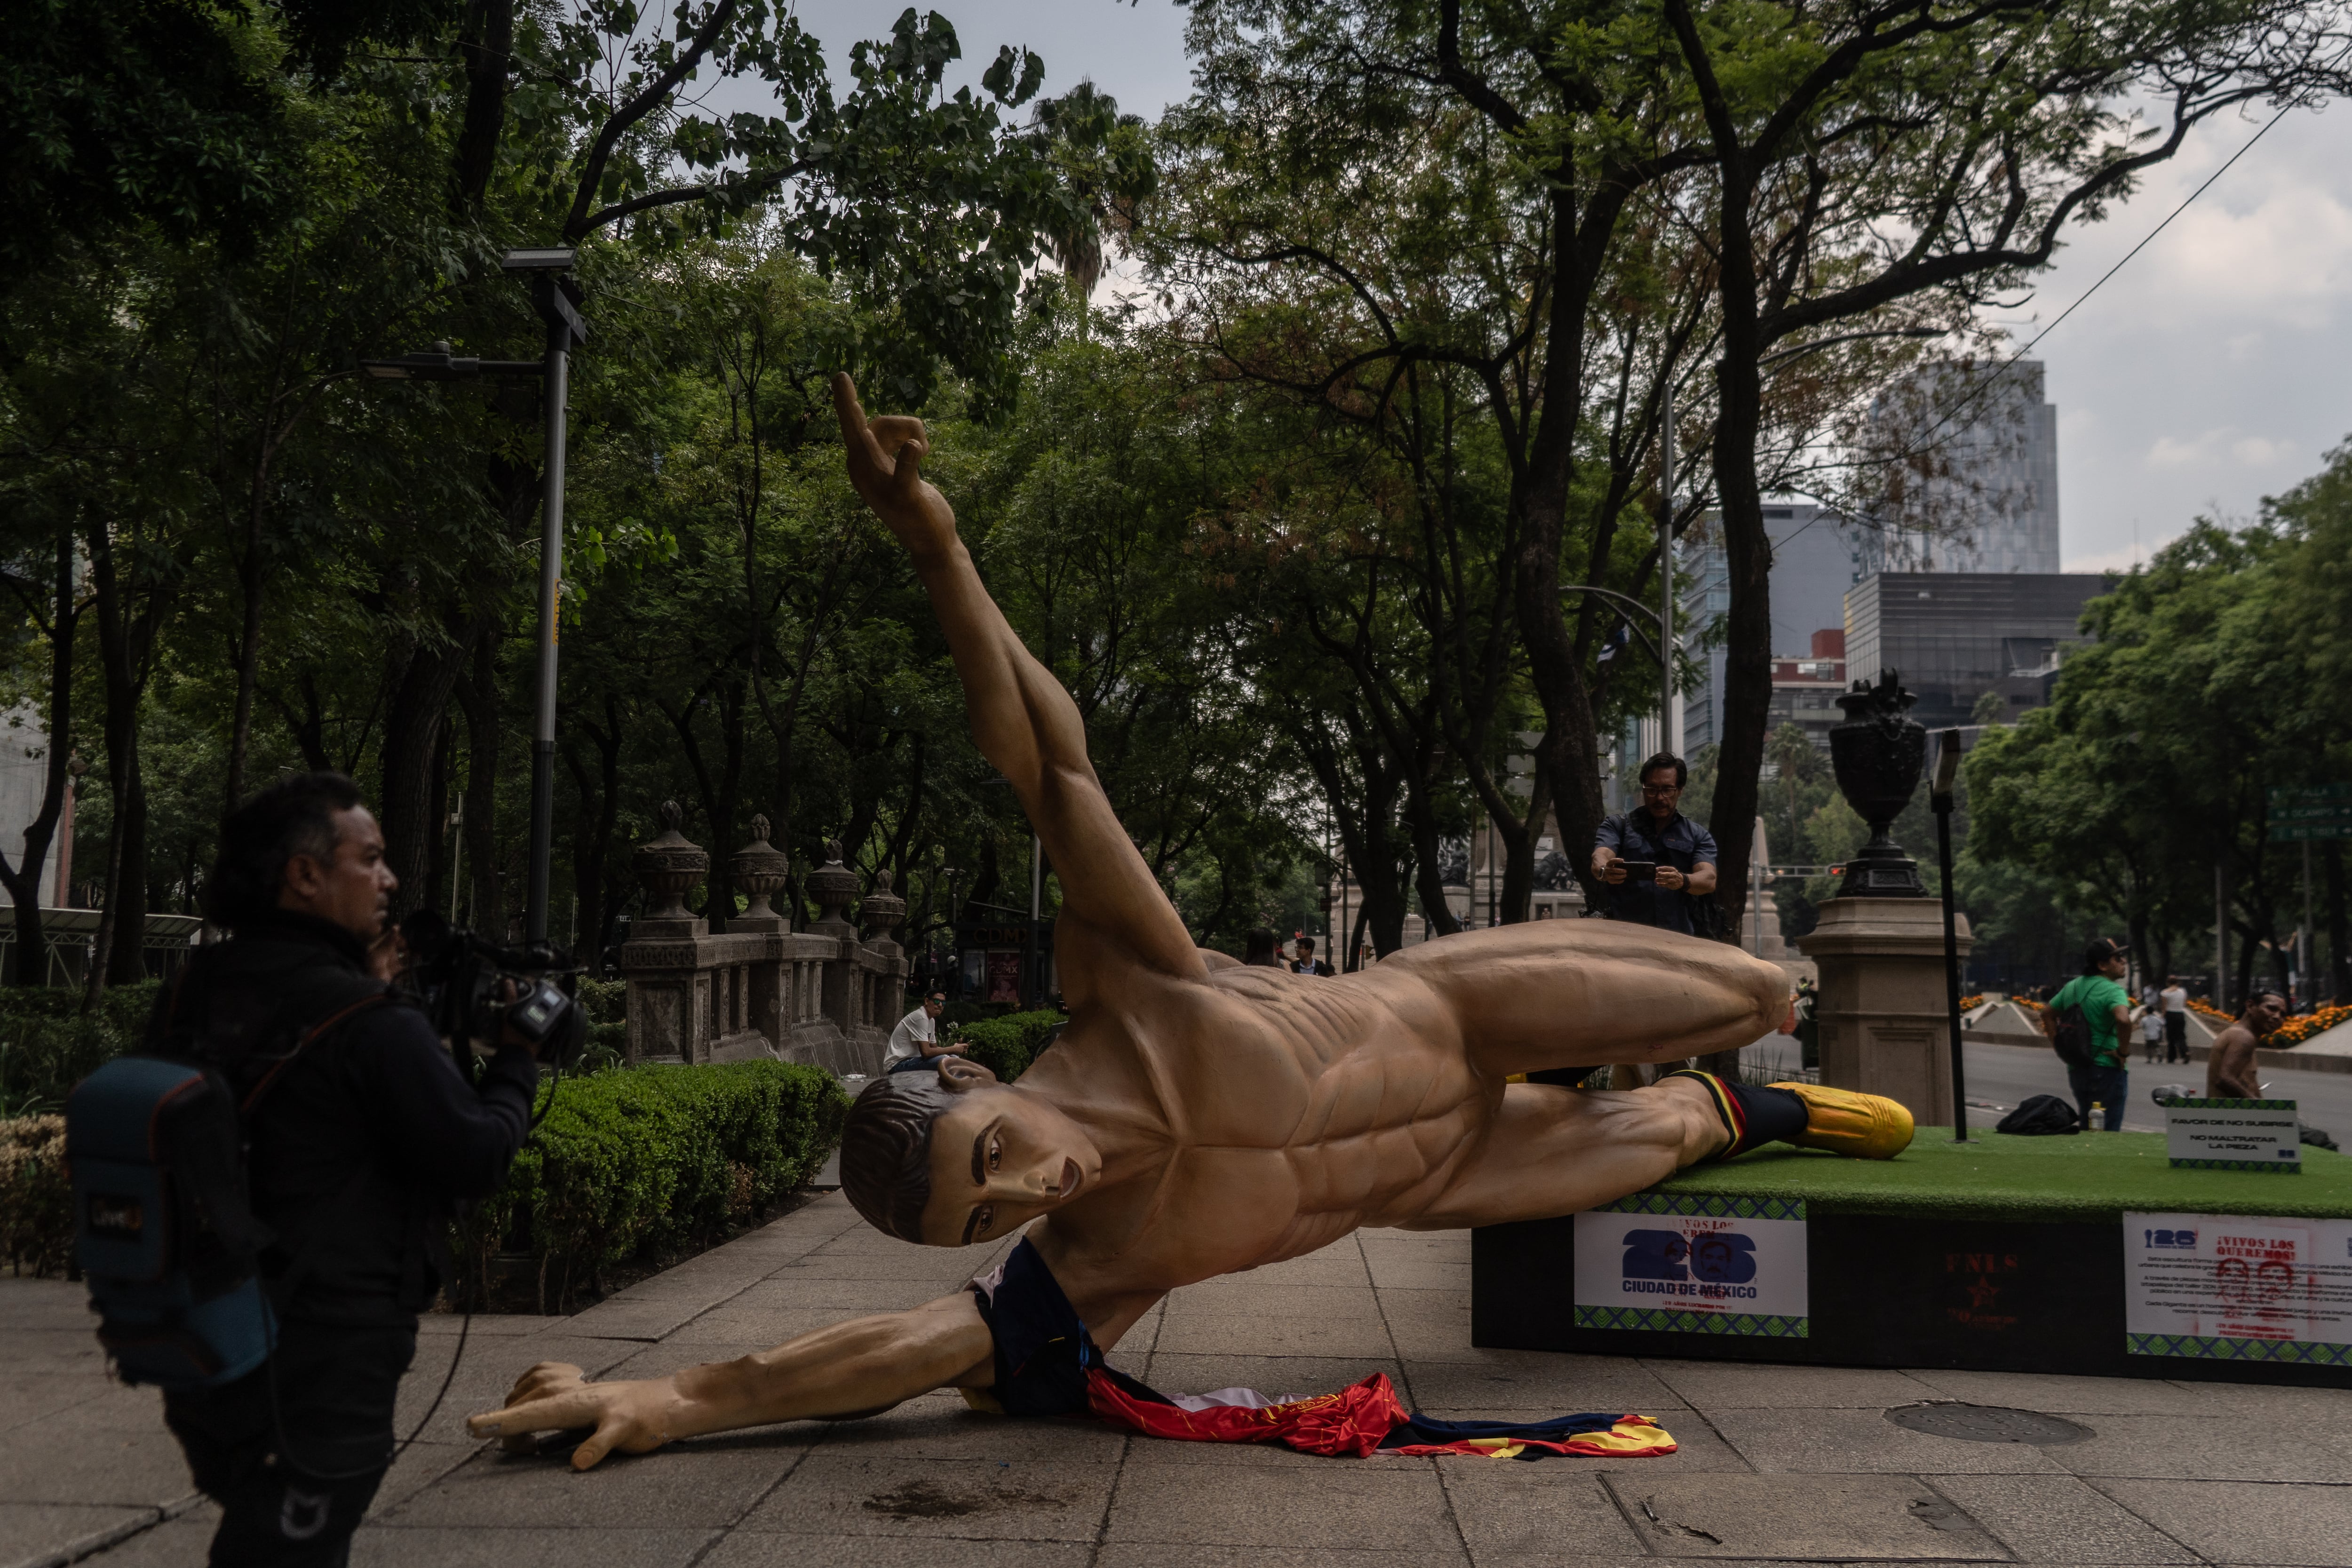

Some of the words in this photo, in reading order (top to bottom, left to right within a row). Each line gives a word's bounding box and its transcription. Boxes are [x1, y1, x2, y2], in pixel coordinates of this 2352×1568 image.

[2217, 1236, 2265, 1247] ¡VIVOS
[2270, 1239, 2294, 1250] LOS
[2217, 1246, 2295, 1261] QUEREMOS!
[1622, 1280, 1676, 1294] CIUDAD
[1678, 1283, 1697, 1295] DE
[1700, 1283, 1757, 1298] MÉXICO
